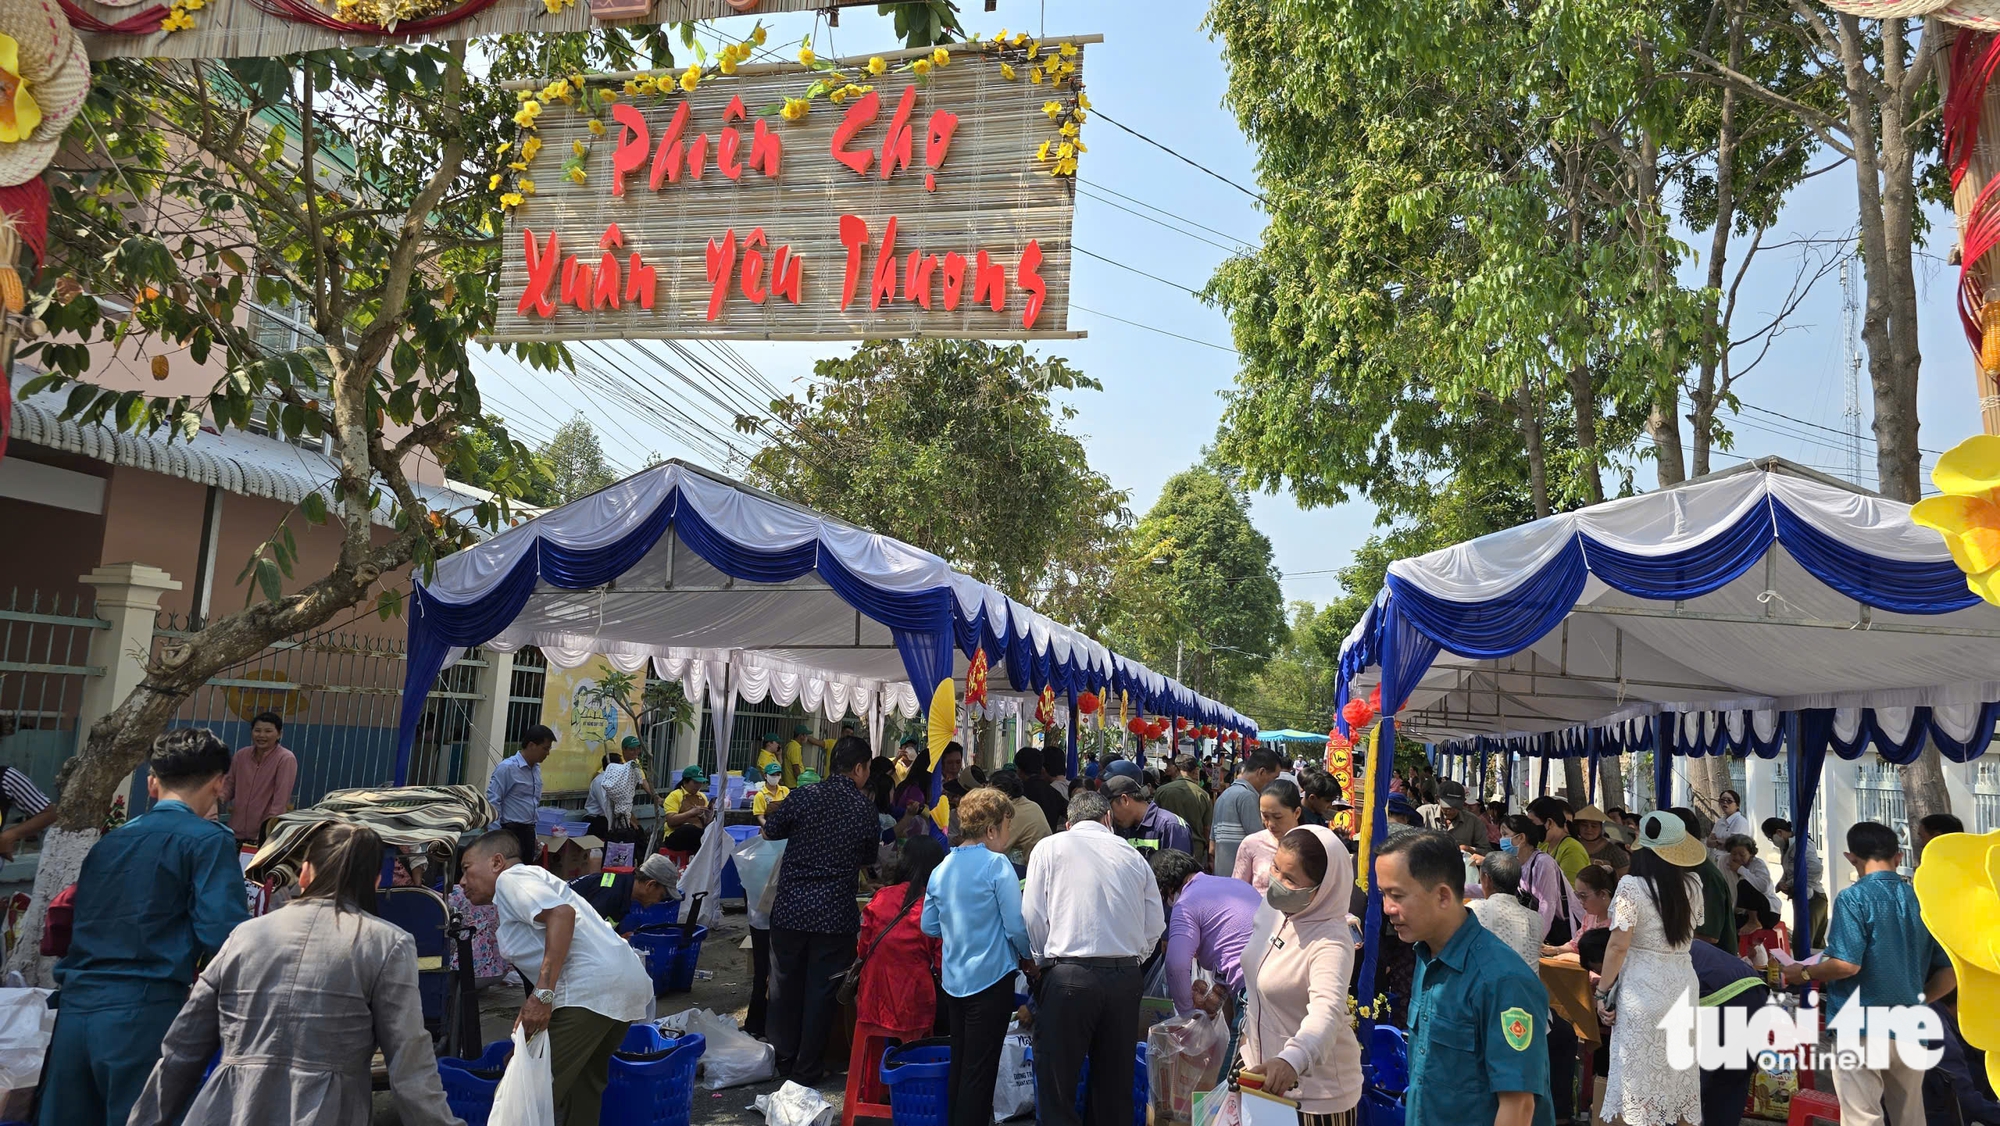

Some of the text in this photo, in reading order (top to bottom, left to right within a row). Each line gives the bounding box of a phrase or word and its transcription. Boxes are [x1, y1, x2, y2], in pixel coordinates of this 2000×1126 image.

[612, 85, 959, 197] Phiên Chợ
[517, 222, 658, 319] Xuân
[706, 227, 802, 321] Yêu
